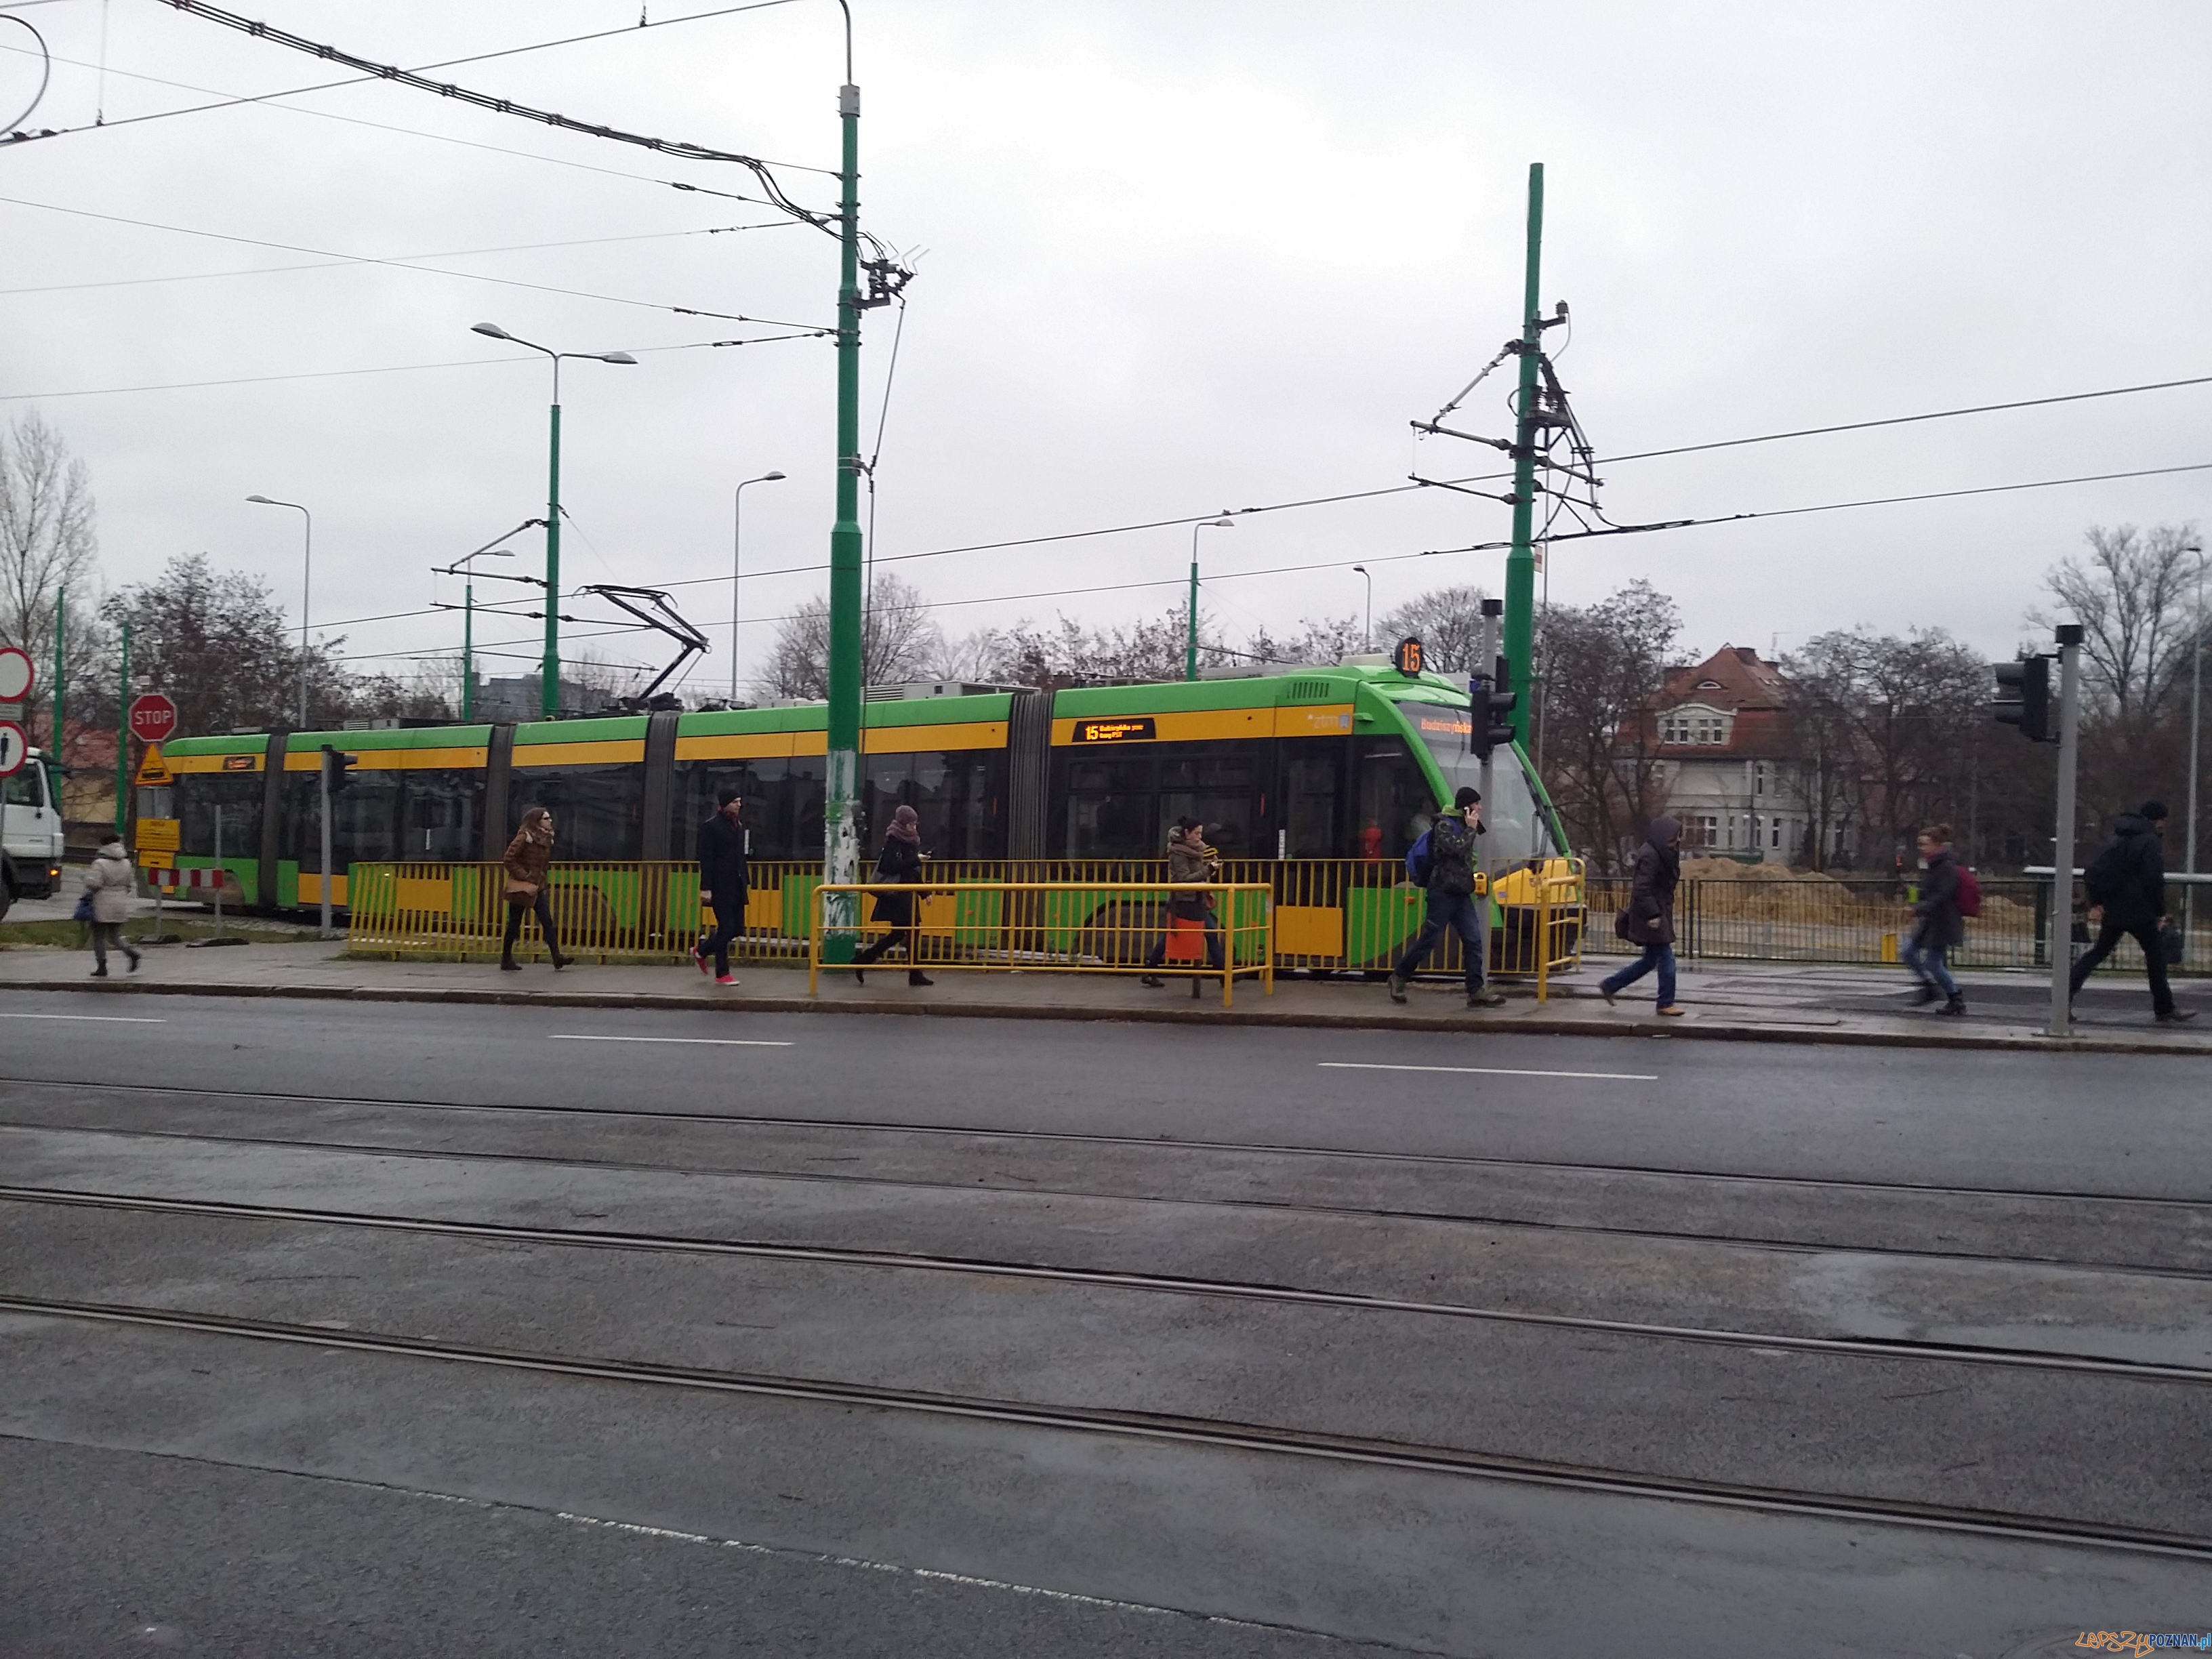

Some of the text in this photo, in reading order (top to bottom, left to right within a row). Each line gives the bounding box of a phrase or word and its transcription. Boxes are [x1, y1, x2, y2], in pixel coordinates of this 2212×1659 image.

[1402, 643, 1420, 672] 15
[135, 710, 172, 724] STOP
[1086, 725, 1099, 740] 15
